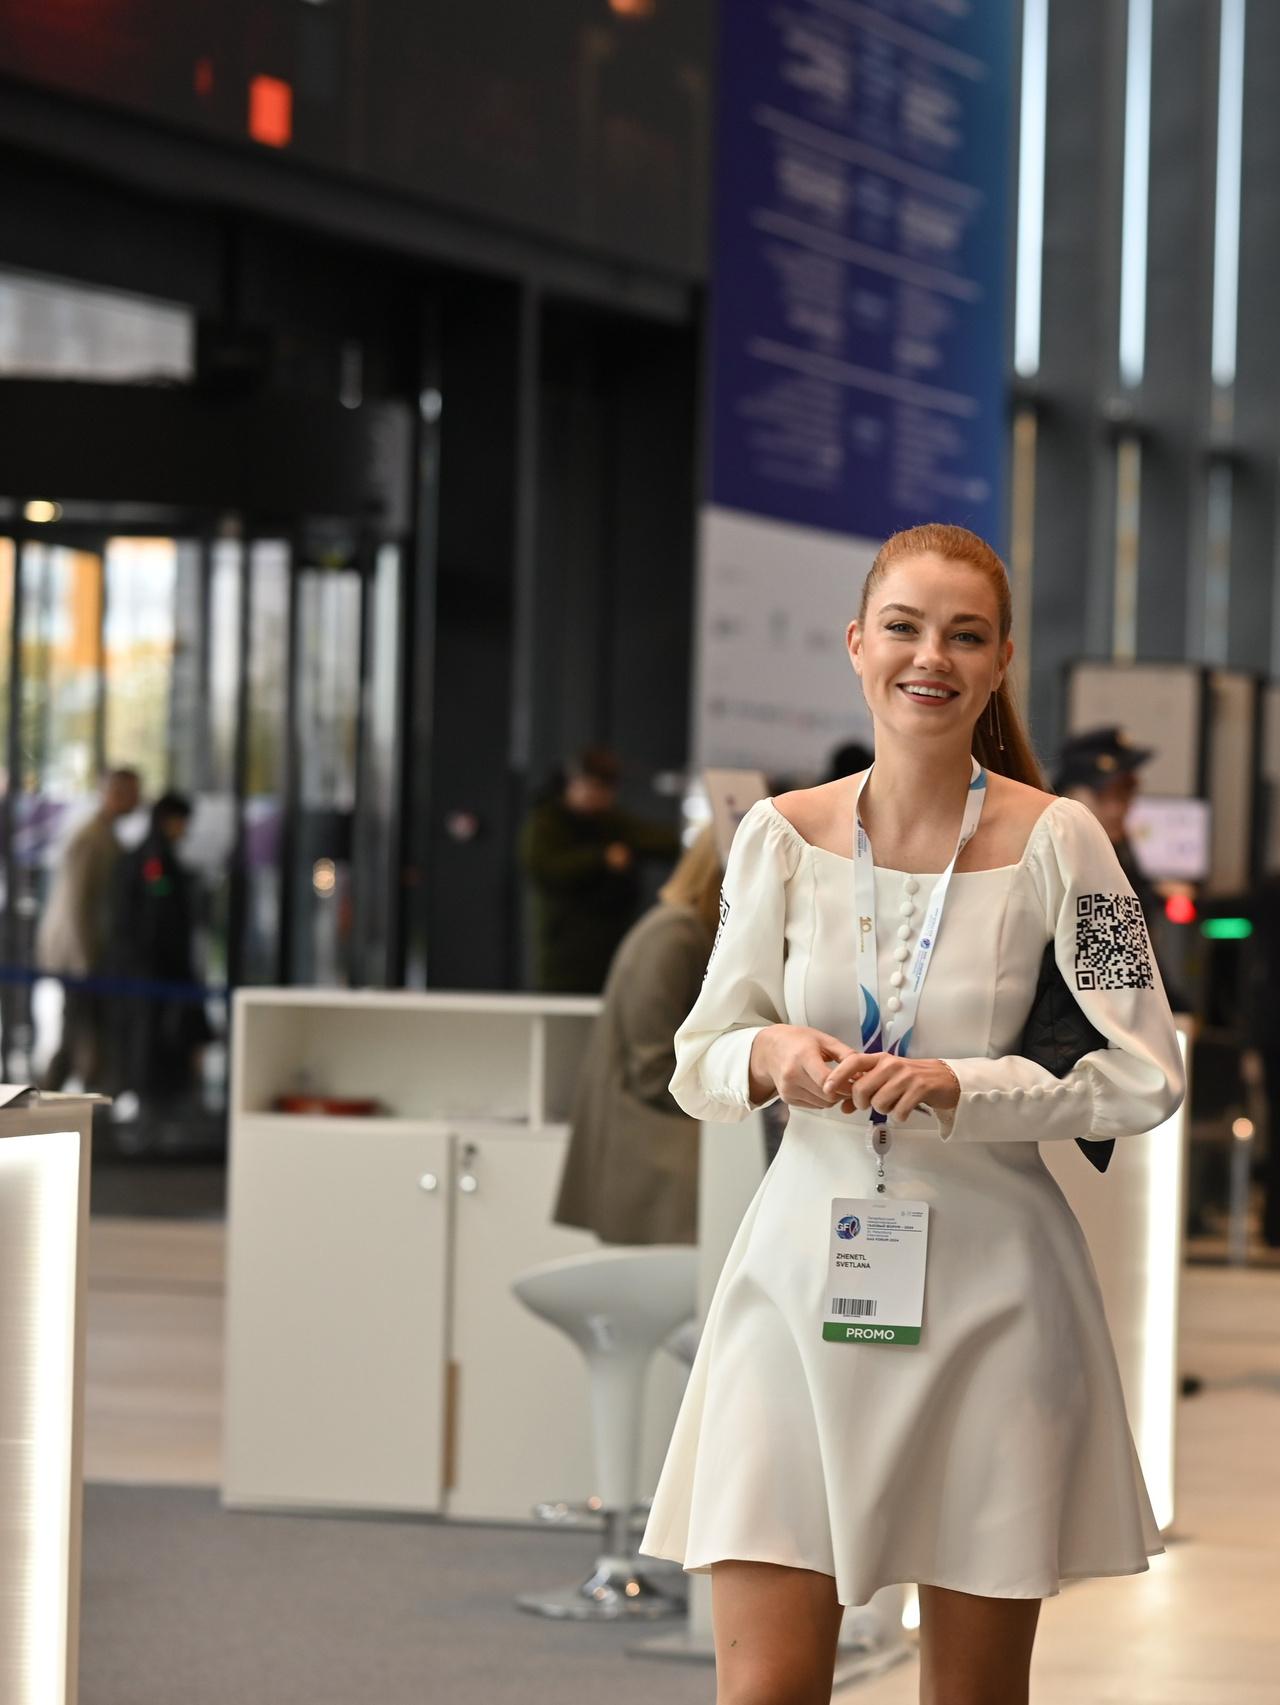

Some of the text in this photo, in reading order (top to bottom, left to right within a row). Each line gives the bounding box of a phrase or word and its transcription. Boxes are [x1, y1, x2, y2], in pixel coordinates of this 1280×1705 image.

[836, 1253, 867, 1261] ZHENETL
[836, 1261, 871, 1269] SVETLANA
[846, 1327, 895, 1340] PROMO
